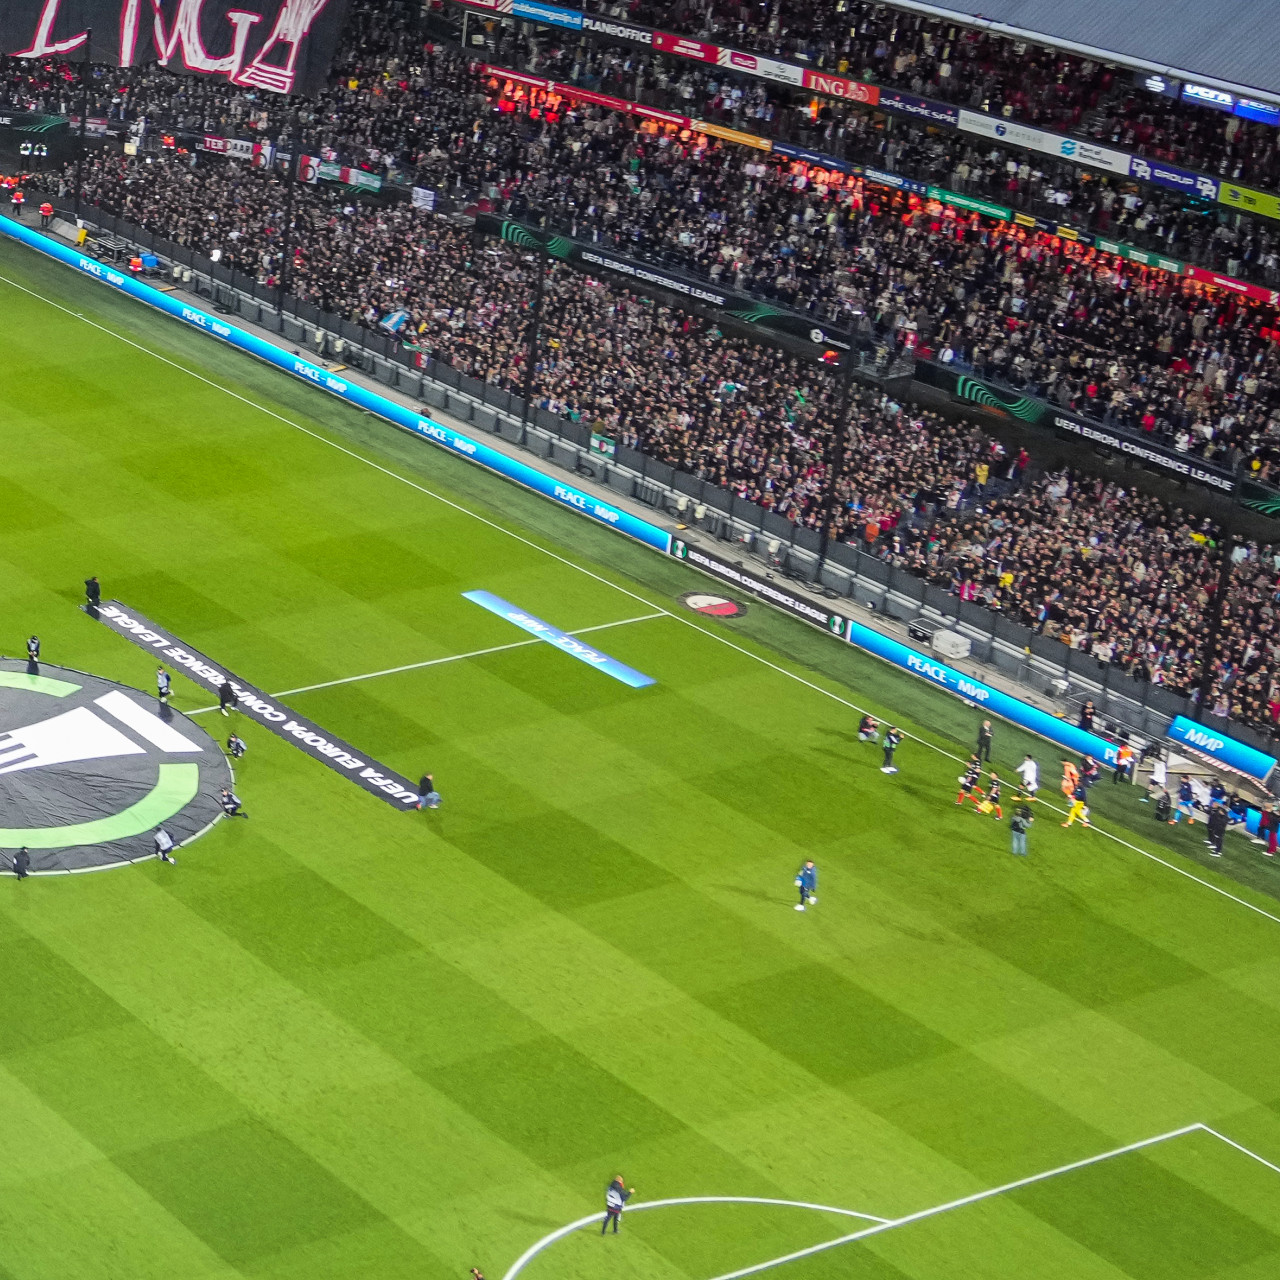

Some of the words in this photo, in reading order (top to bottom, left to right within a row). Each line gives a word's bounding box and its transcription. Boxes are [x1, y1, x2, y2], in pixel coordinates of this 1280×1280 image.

[774, 73, 800, 84] WORLD
[810, 75, 844, 96] ING
[1154, 169, 1195, 185] GROUP
[79, 258, 102, 276] PEACE
[581, 251, 603, 265] UEFA
[603, 258, 636, 275] EUROPA
[690, 286, 726, 305] LEAGUE
[182, 307, 207, 327] PEACE
[294, 361, 320, 381] PEACE
[417, 420, 446, 442] PEACE
[1054, 417, 1081, 435] UEFA
[1082, 427, 1121, 449] EUROPA
[1121, 442, 1190, 475] CONFERENCE
[1190, 467, 1235, 492] LEAGUE
[553, 485, 587, 510] PEACE
[688, 550, 712, 567] UEFA
[710, 560, 741, 581] EUROPA
[741, 574, 796, 608] CONFERENCE
[794, 600, 829, 624] LEAGUE
[92, 605, 171, 648] LEAGUE
[552, 636, 608, 664] PEACE
[906, 654, 948, 684] PEACE
[163, 646, 288, 722] CONFRENCE
[282, 720, 366, 770] EUROPA
[358, 767, 419, 804] UEFA
